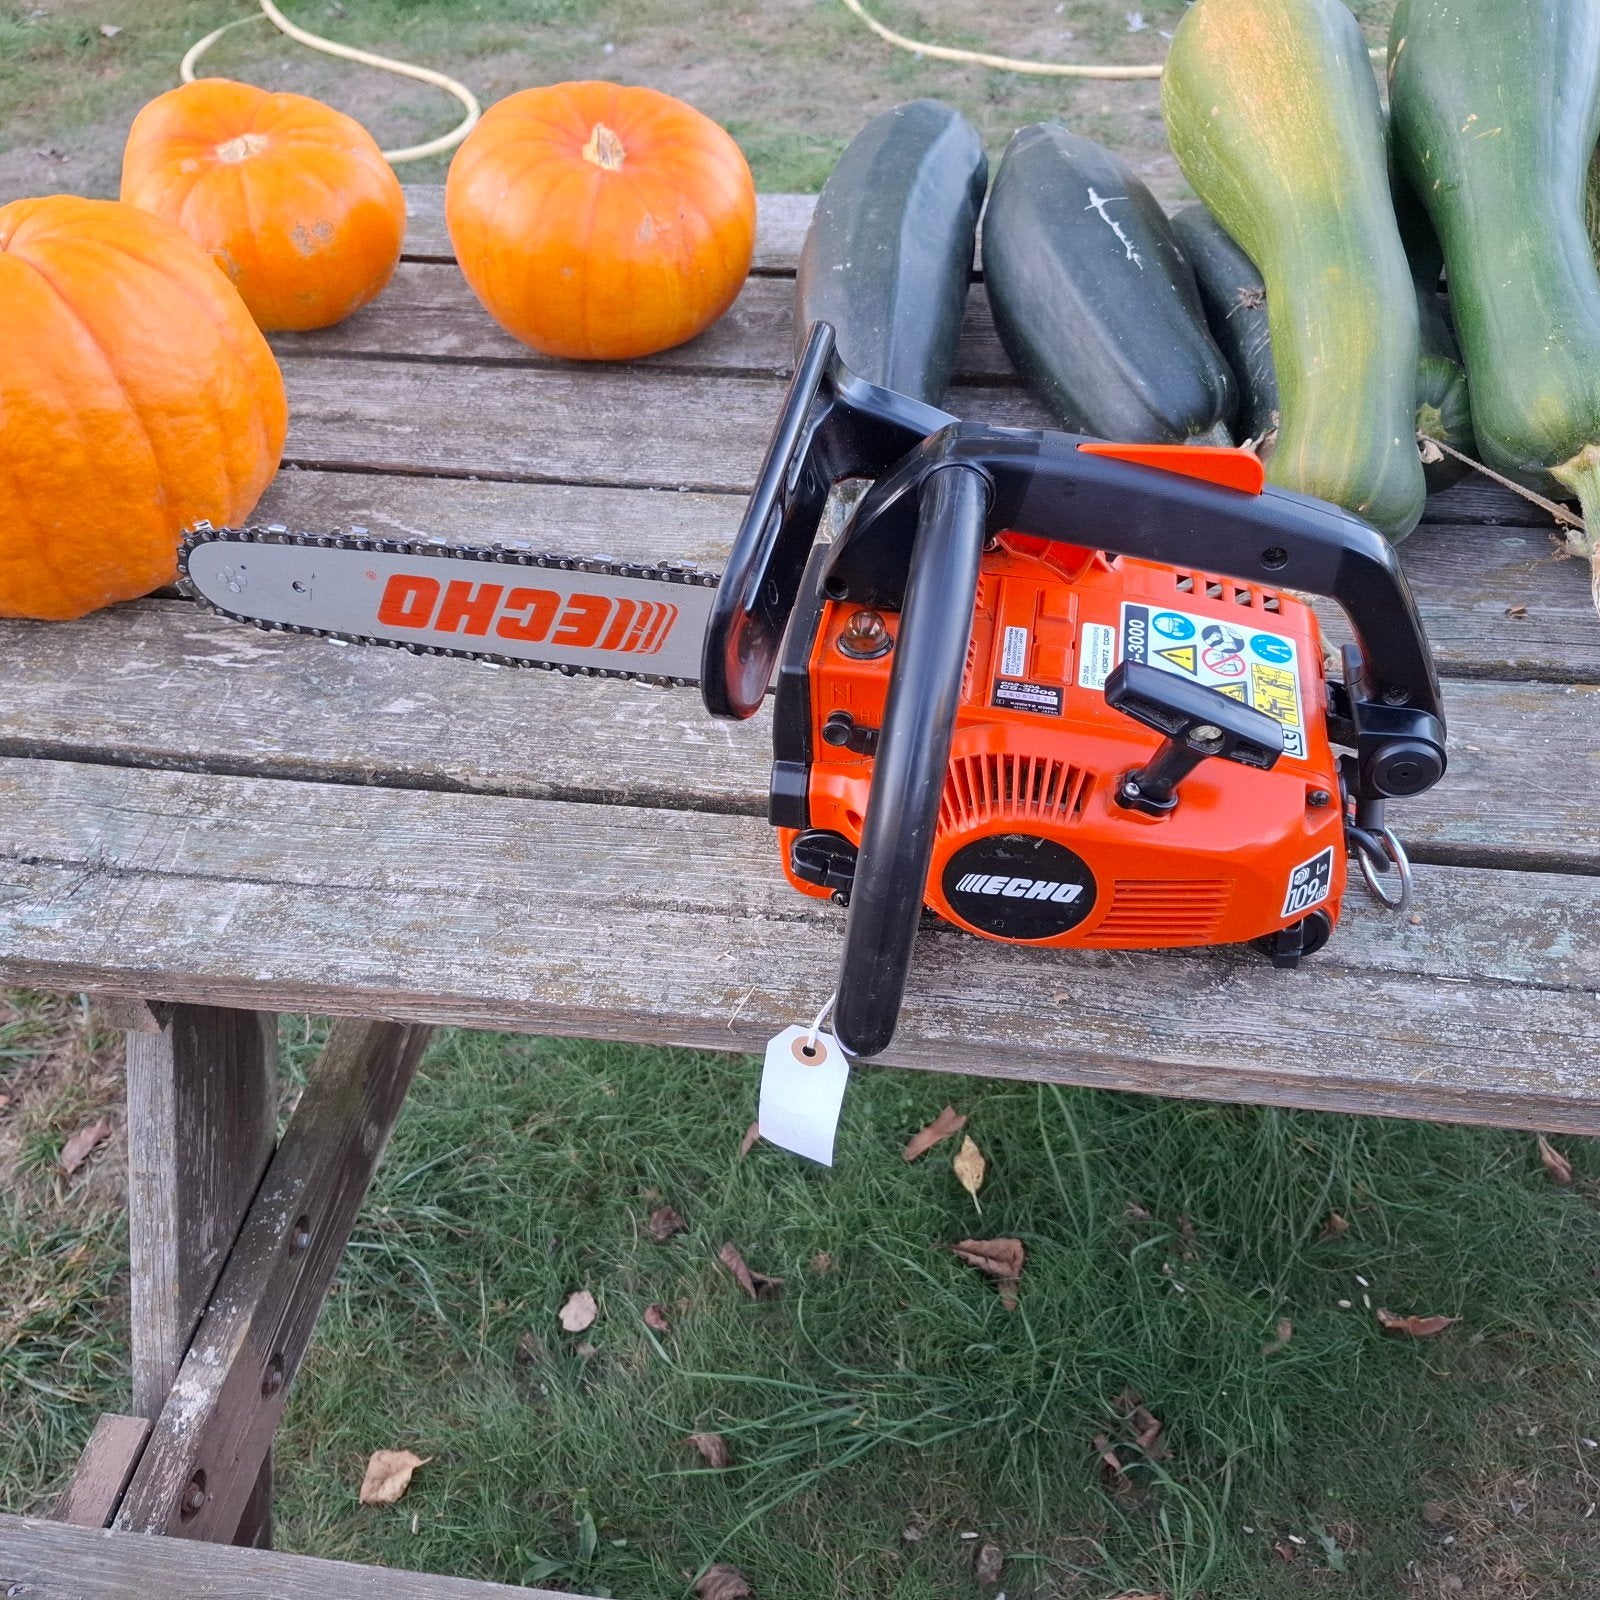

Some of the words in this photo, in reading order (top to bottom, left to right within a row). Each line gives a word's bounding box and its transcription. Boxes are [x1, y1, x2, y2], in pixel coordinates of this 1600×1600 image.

[377, 574, 613, 648] ECHO
[1128, 619, 1145, 663] -3000
[981, 875, 1084, 903] ECHO
